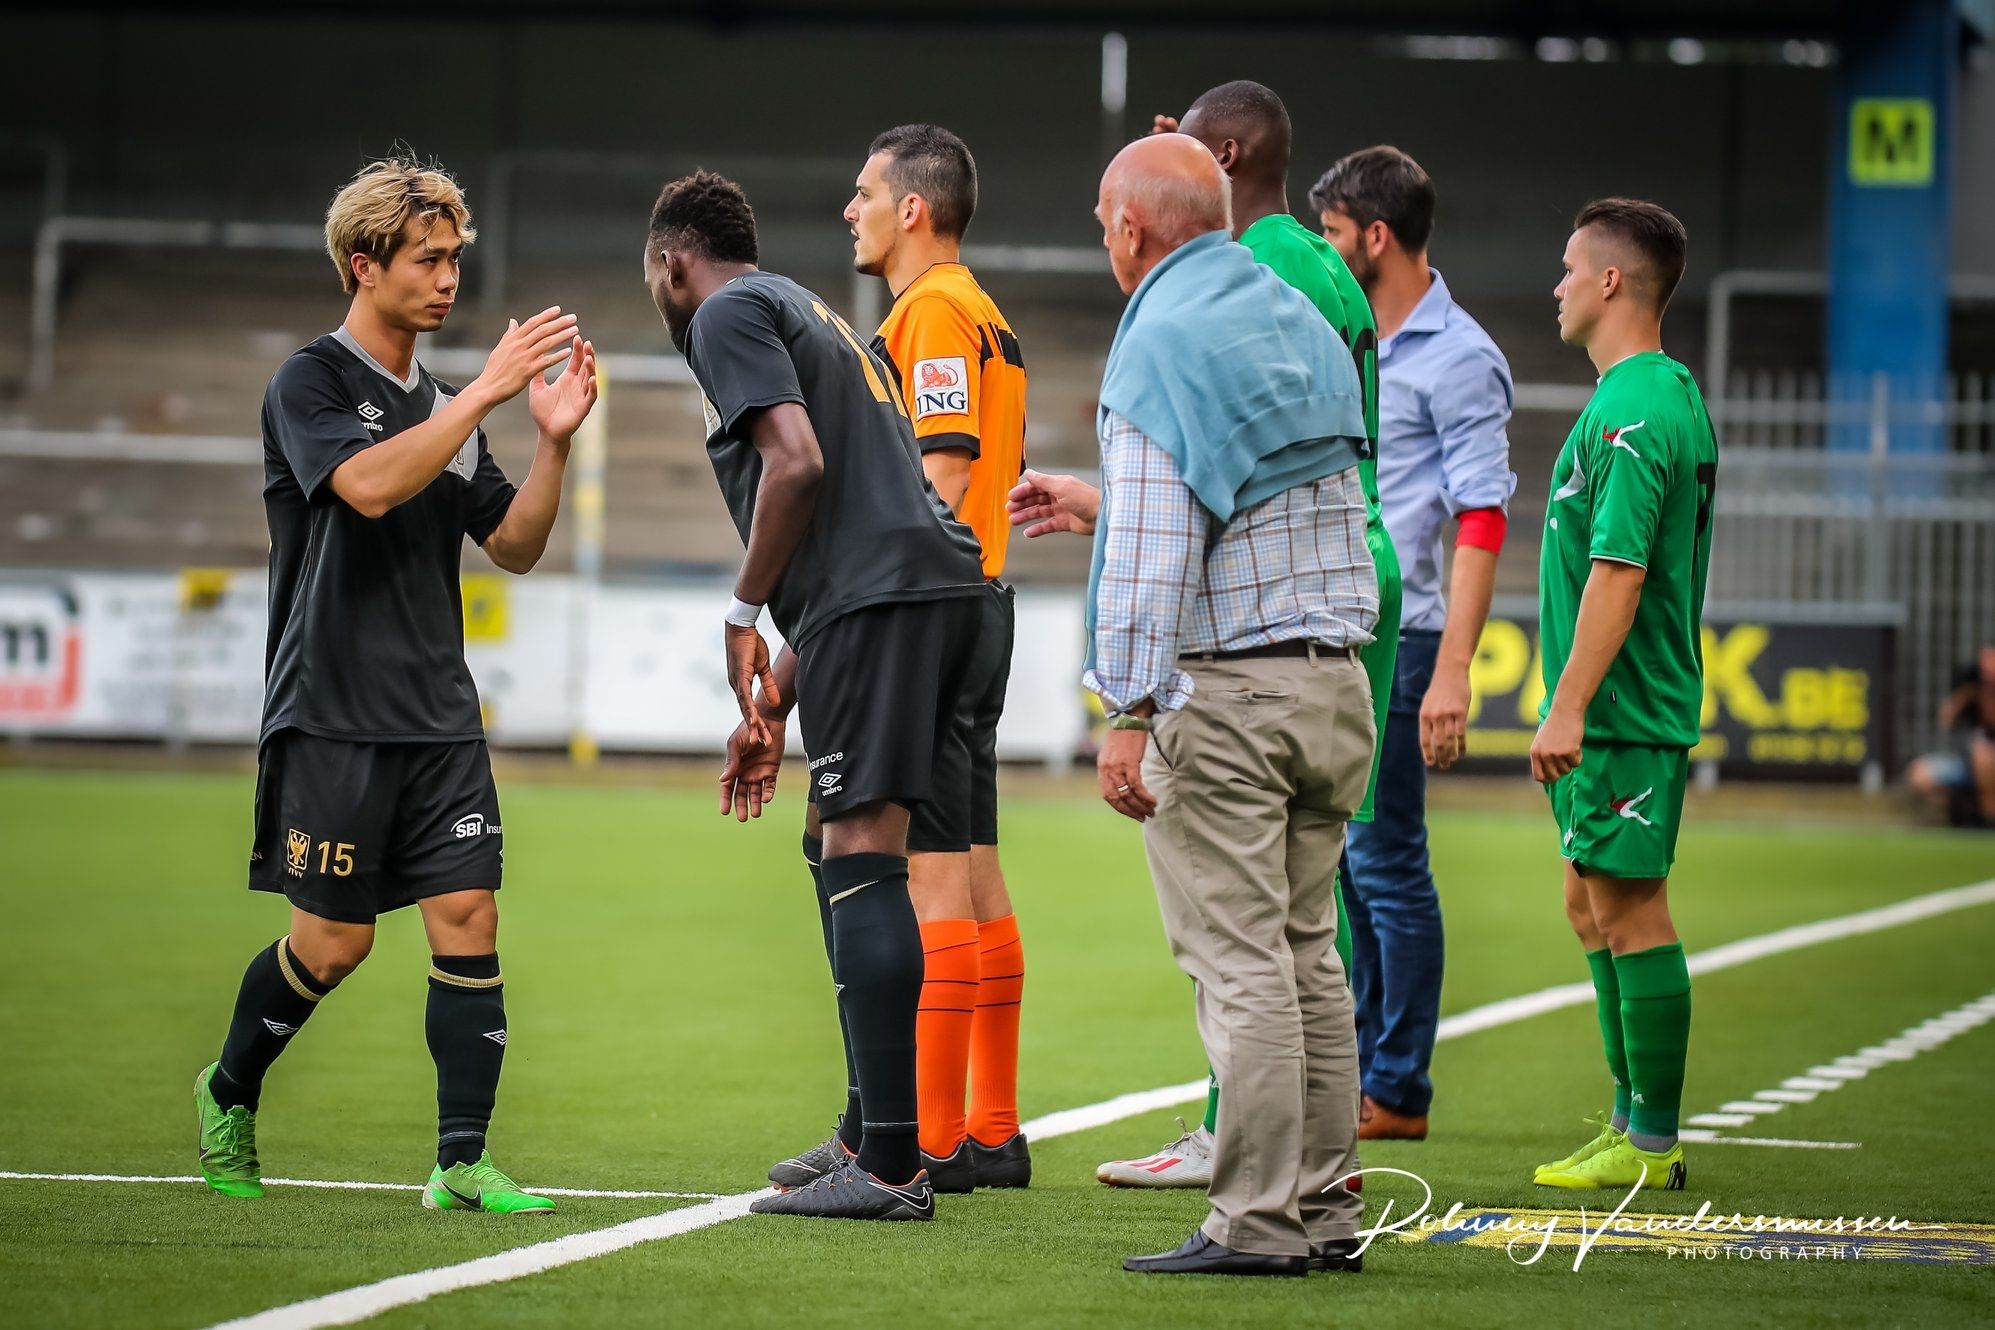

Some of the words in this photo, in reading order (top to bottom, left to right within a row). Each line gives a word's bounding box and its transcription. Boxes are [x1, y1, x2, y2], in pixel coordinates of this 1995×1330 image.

[1865, 111, 1920, 165] M
[916, 391, 967, 416] ING
[361, 421, 384, 432] mbro
[822, 785, 843, 797] umbro
[455, 820, 482, 839] SBI
[318, 841, 356, 877] 15
